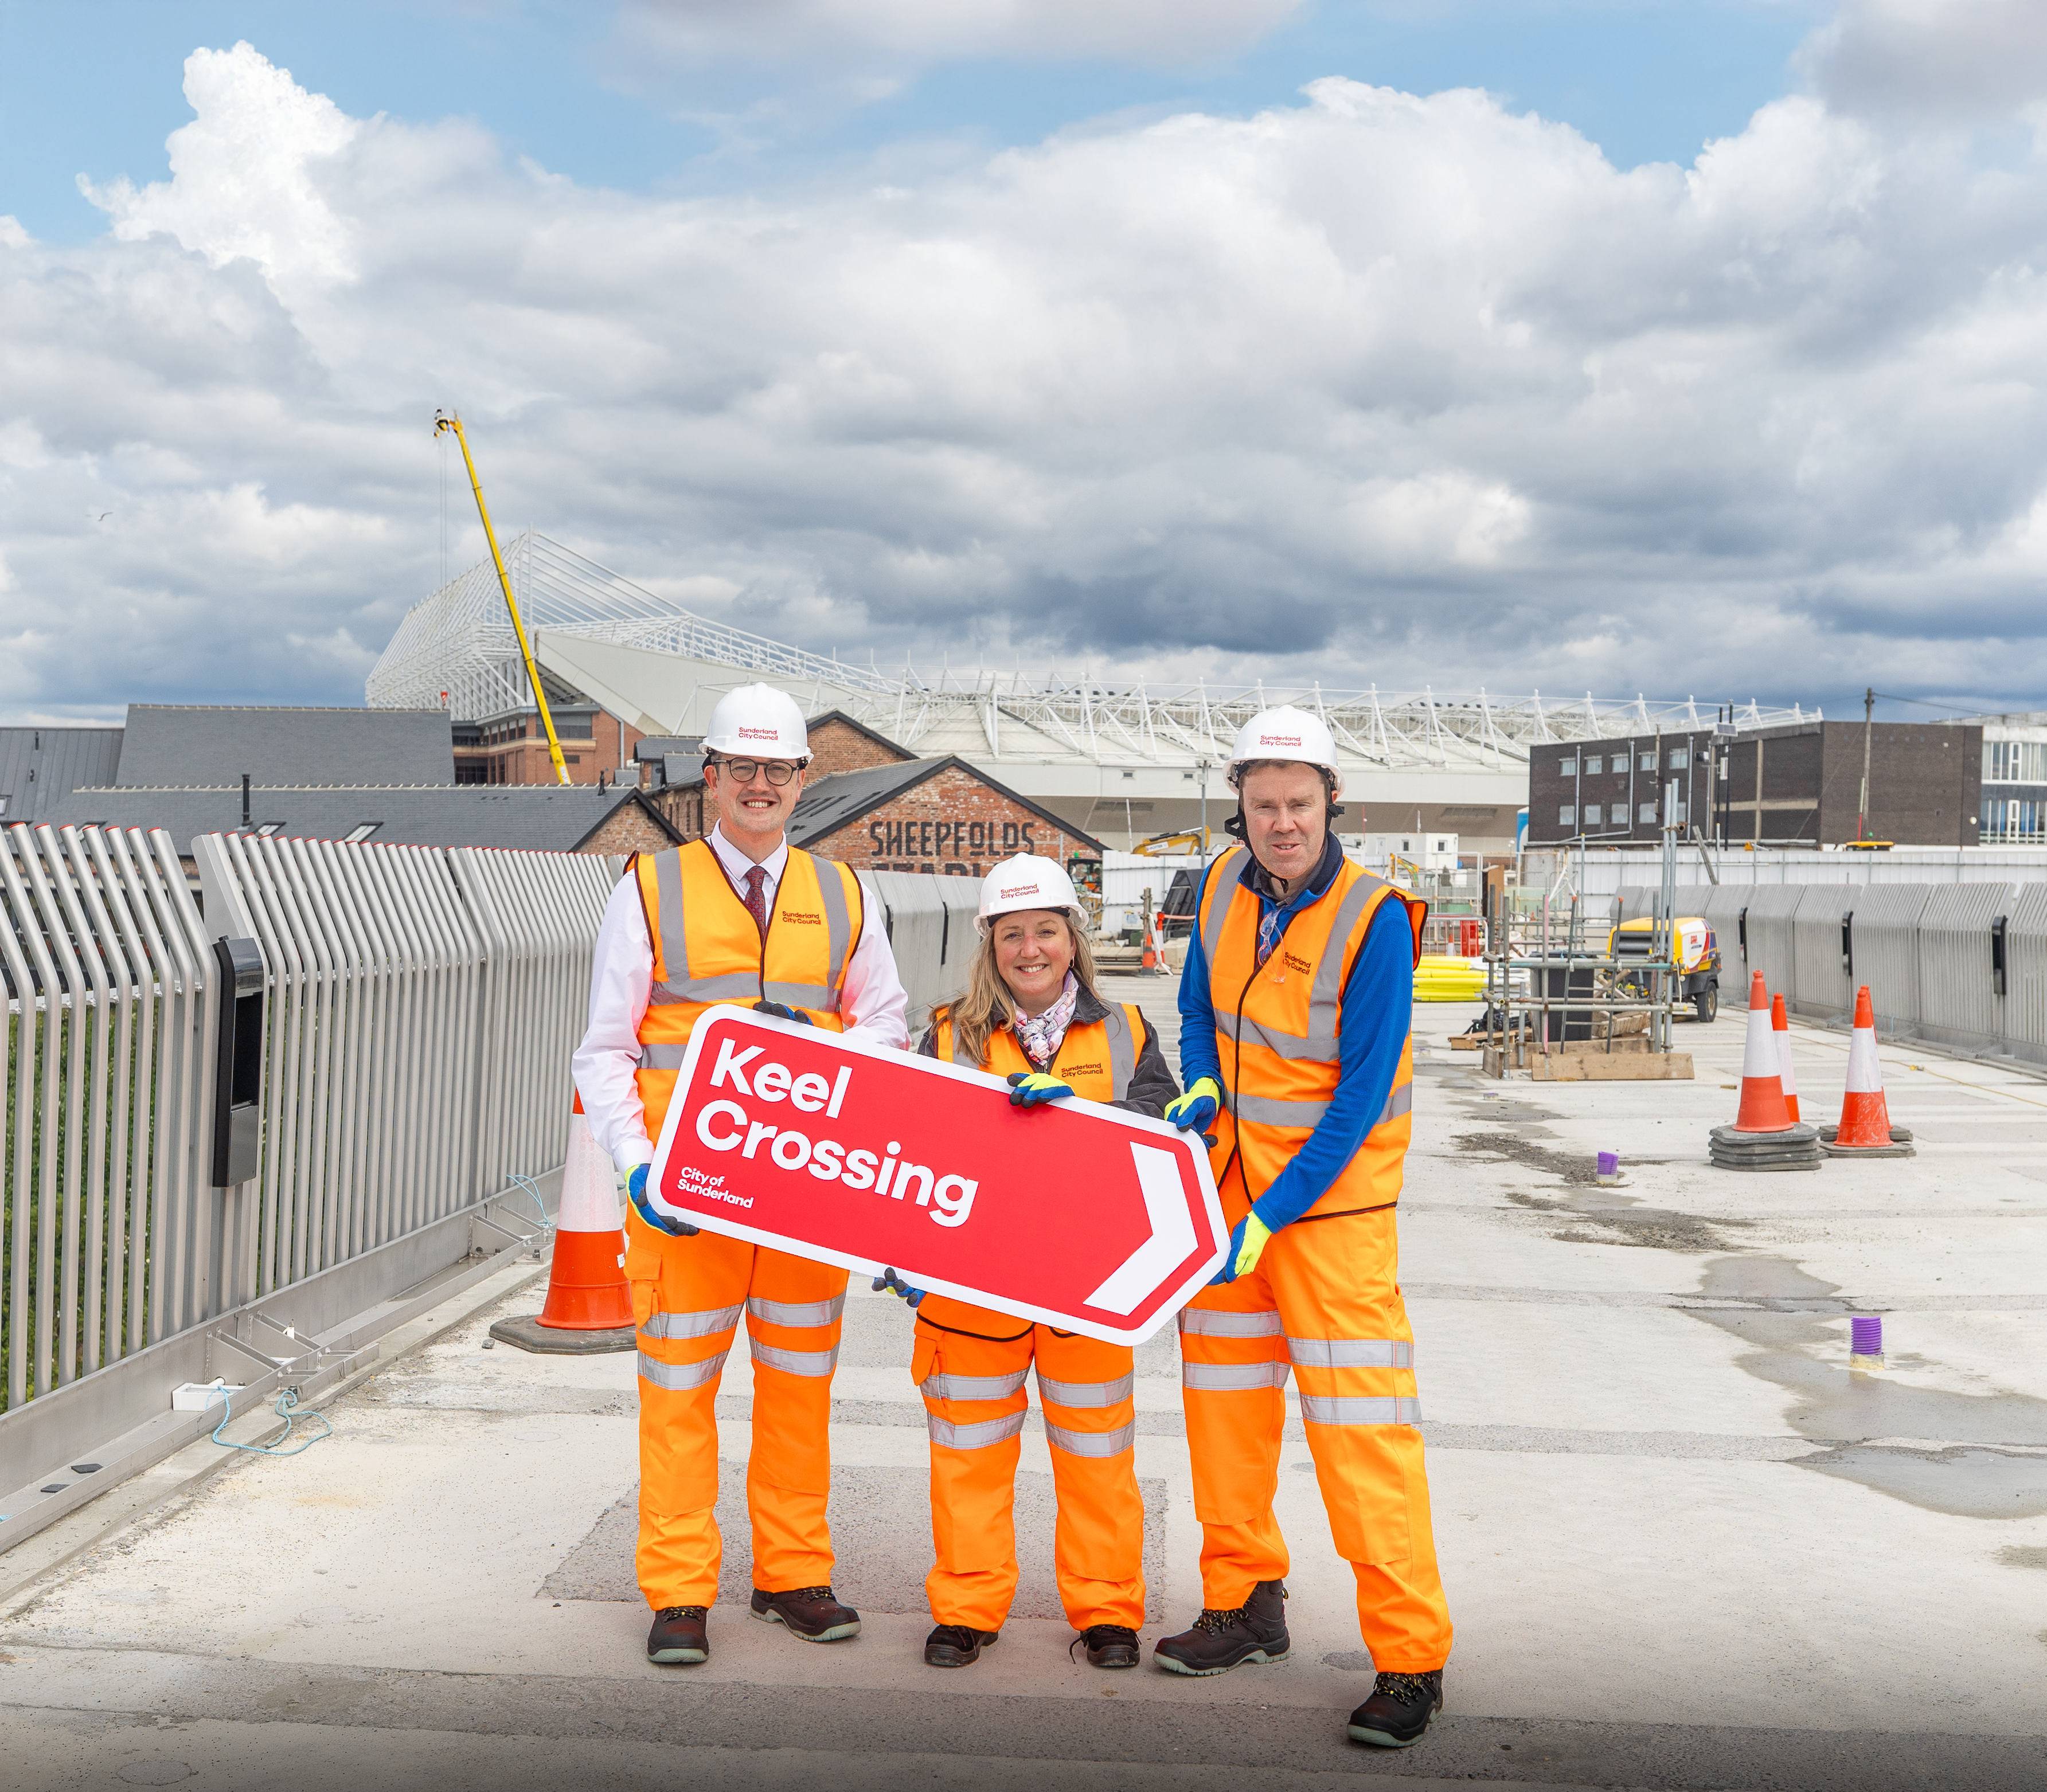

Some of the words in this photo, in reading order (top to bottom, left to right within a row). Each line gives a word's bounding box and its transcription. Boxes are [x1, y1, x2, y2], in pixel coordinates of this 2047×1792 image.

[739, 727, 777, 735] Sunderland
[870, 821, 1034, 856] SHEEPFOLDS
[1001, 883, 1037, 894] Sunderland
[1015, 889, 1039, 897] Council
[782, 911, 819, 919] Sunderland
[1061, 1062, 1101, 1073] Sunderland
[709, 1037, 853, 1119] Keel
[696, 1099, 979, 1227] Crossing
[681, 1167, 710, 1185] City
[709, 1176, 725, 1187] of
[677, 1178, 754, 1209] Sunderland
